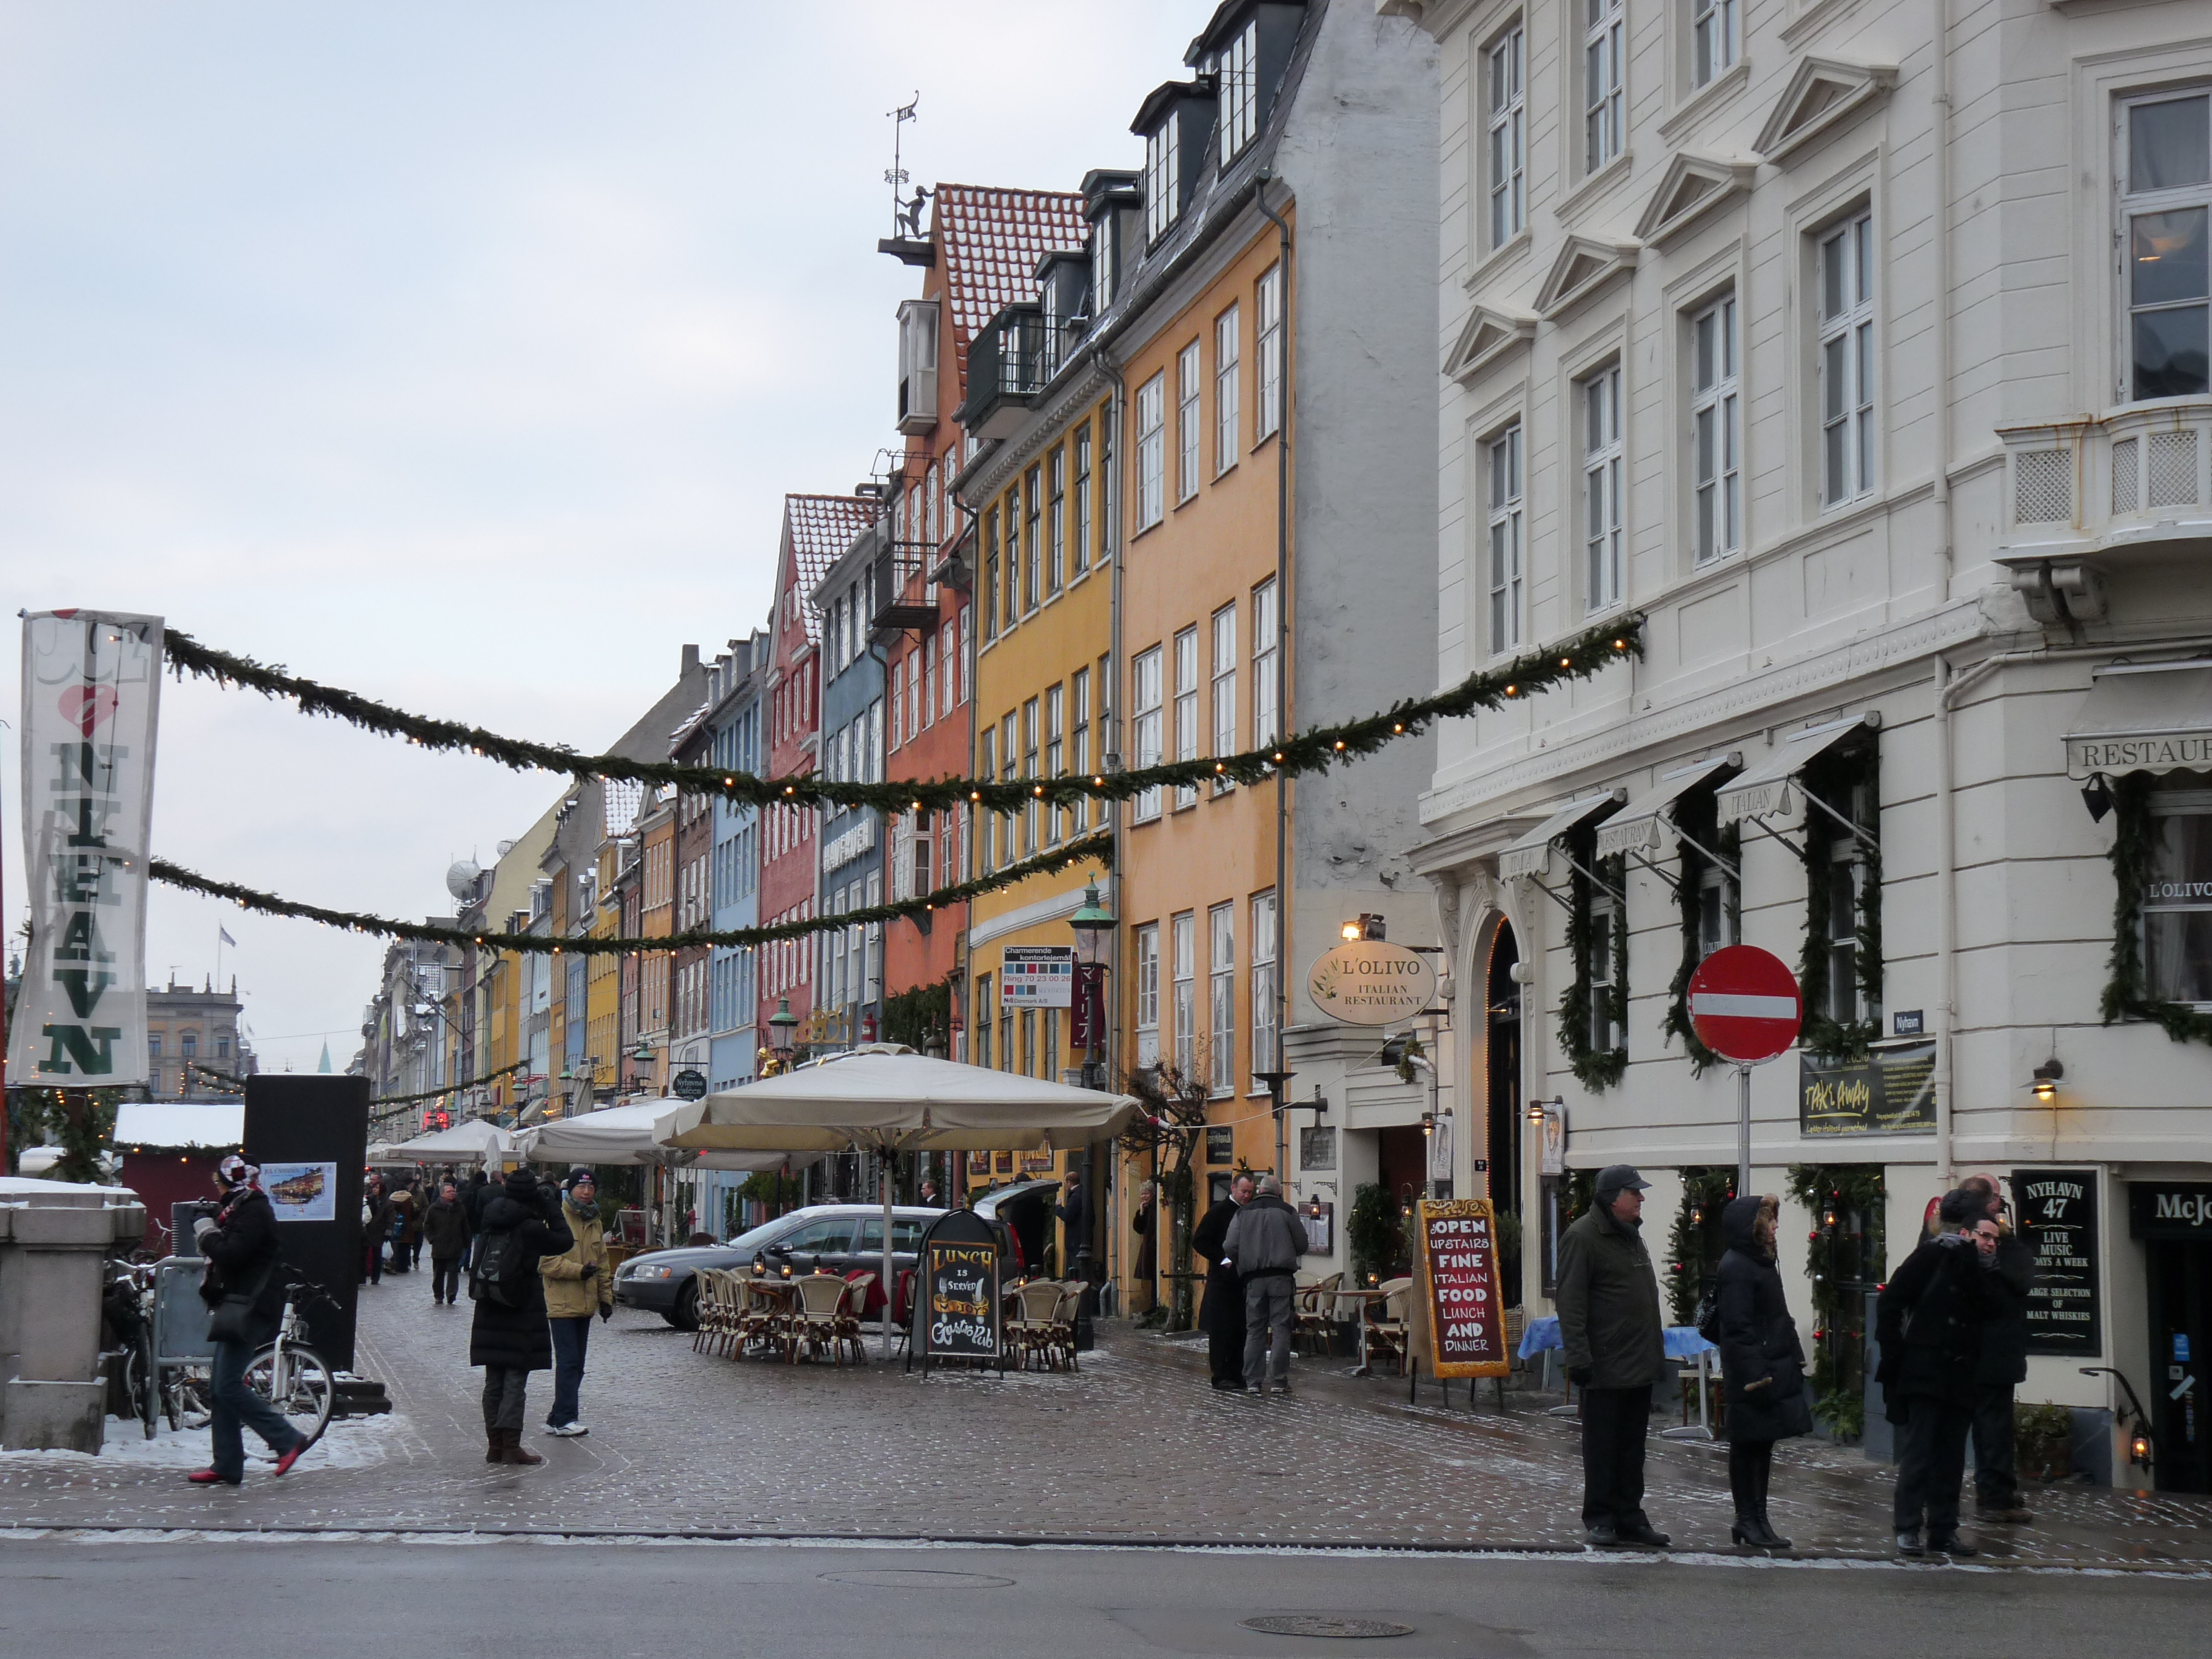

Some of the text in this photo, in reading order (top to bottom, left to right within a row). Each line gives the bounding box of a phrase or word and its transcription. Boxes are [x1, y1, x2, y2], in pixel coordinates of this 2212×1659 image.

[1731, 788, 1771, 814] ITALIAN
[2148, 881, 2212, 897] L'OLIVO
[1342, 957, 1420, 975] L'OLIVO
[1358, 985, 1408, 994] ITALIAN
[1344, 996, 1422, 1005] RESTAURANT
[1896, 1017, 1919, 1031] Nyhavn
[677, 1078, 703, 1088] Nyhavns
[1837, 1079, 1869, 1113] AWAY
[2026, 1182, 2084, 1199] NYHAVN
[2043, 1198, 2068, 1218] 47
[1435, 1219, 1486, 1233] OPEN
[1430, 1238, 1489, 1249] UPSTAIRS
[2043, 1232, 2068, 1243] LIVE
[2040, 1244, 2073, 1255] MUSIC
[932, 1249, 993, 1275] LUNCH
[1438, 1253, 1483, 1268] FINE
[2055, 1258, 2062, 1266] A
[2063, 1258, 2088, 1267] WEEK
[1434, 1272, 1487, 1284] ITALIAN
[1438, 1289, 1487, 1302] FOOD
[2026, 1288, 2091, 1297] ARGE SELECTION
[2053, 1299, 2063, 1308] OF
[1443, 1307, 1486, 1319] LUNCH
[2026, 1310, 2091, 1321] MALT WHISKIES
[1447, 1322, 1484, 1338] AND
[1444, 1339, 1489, 1352] DINNER
